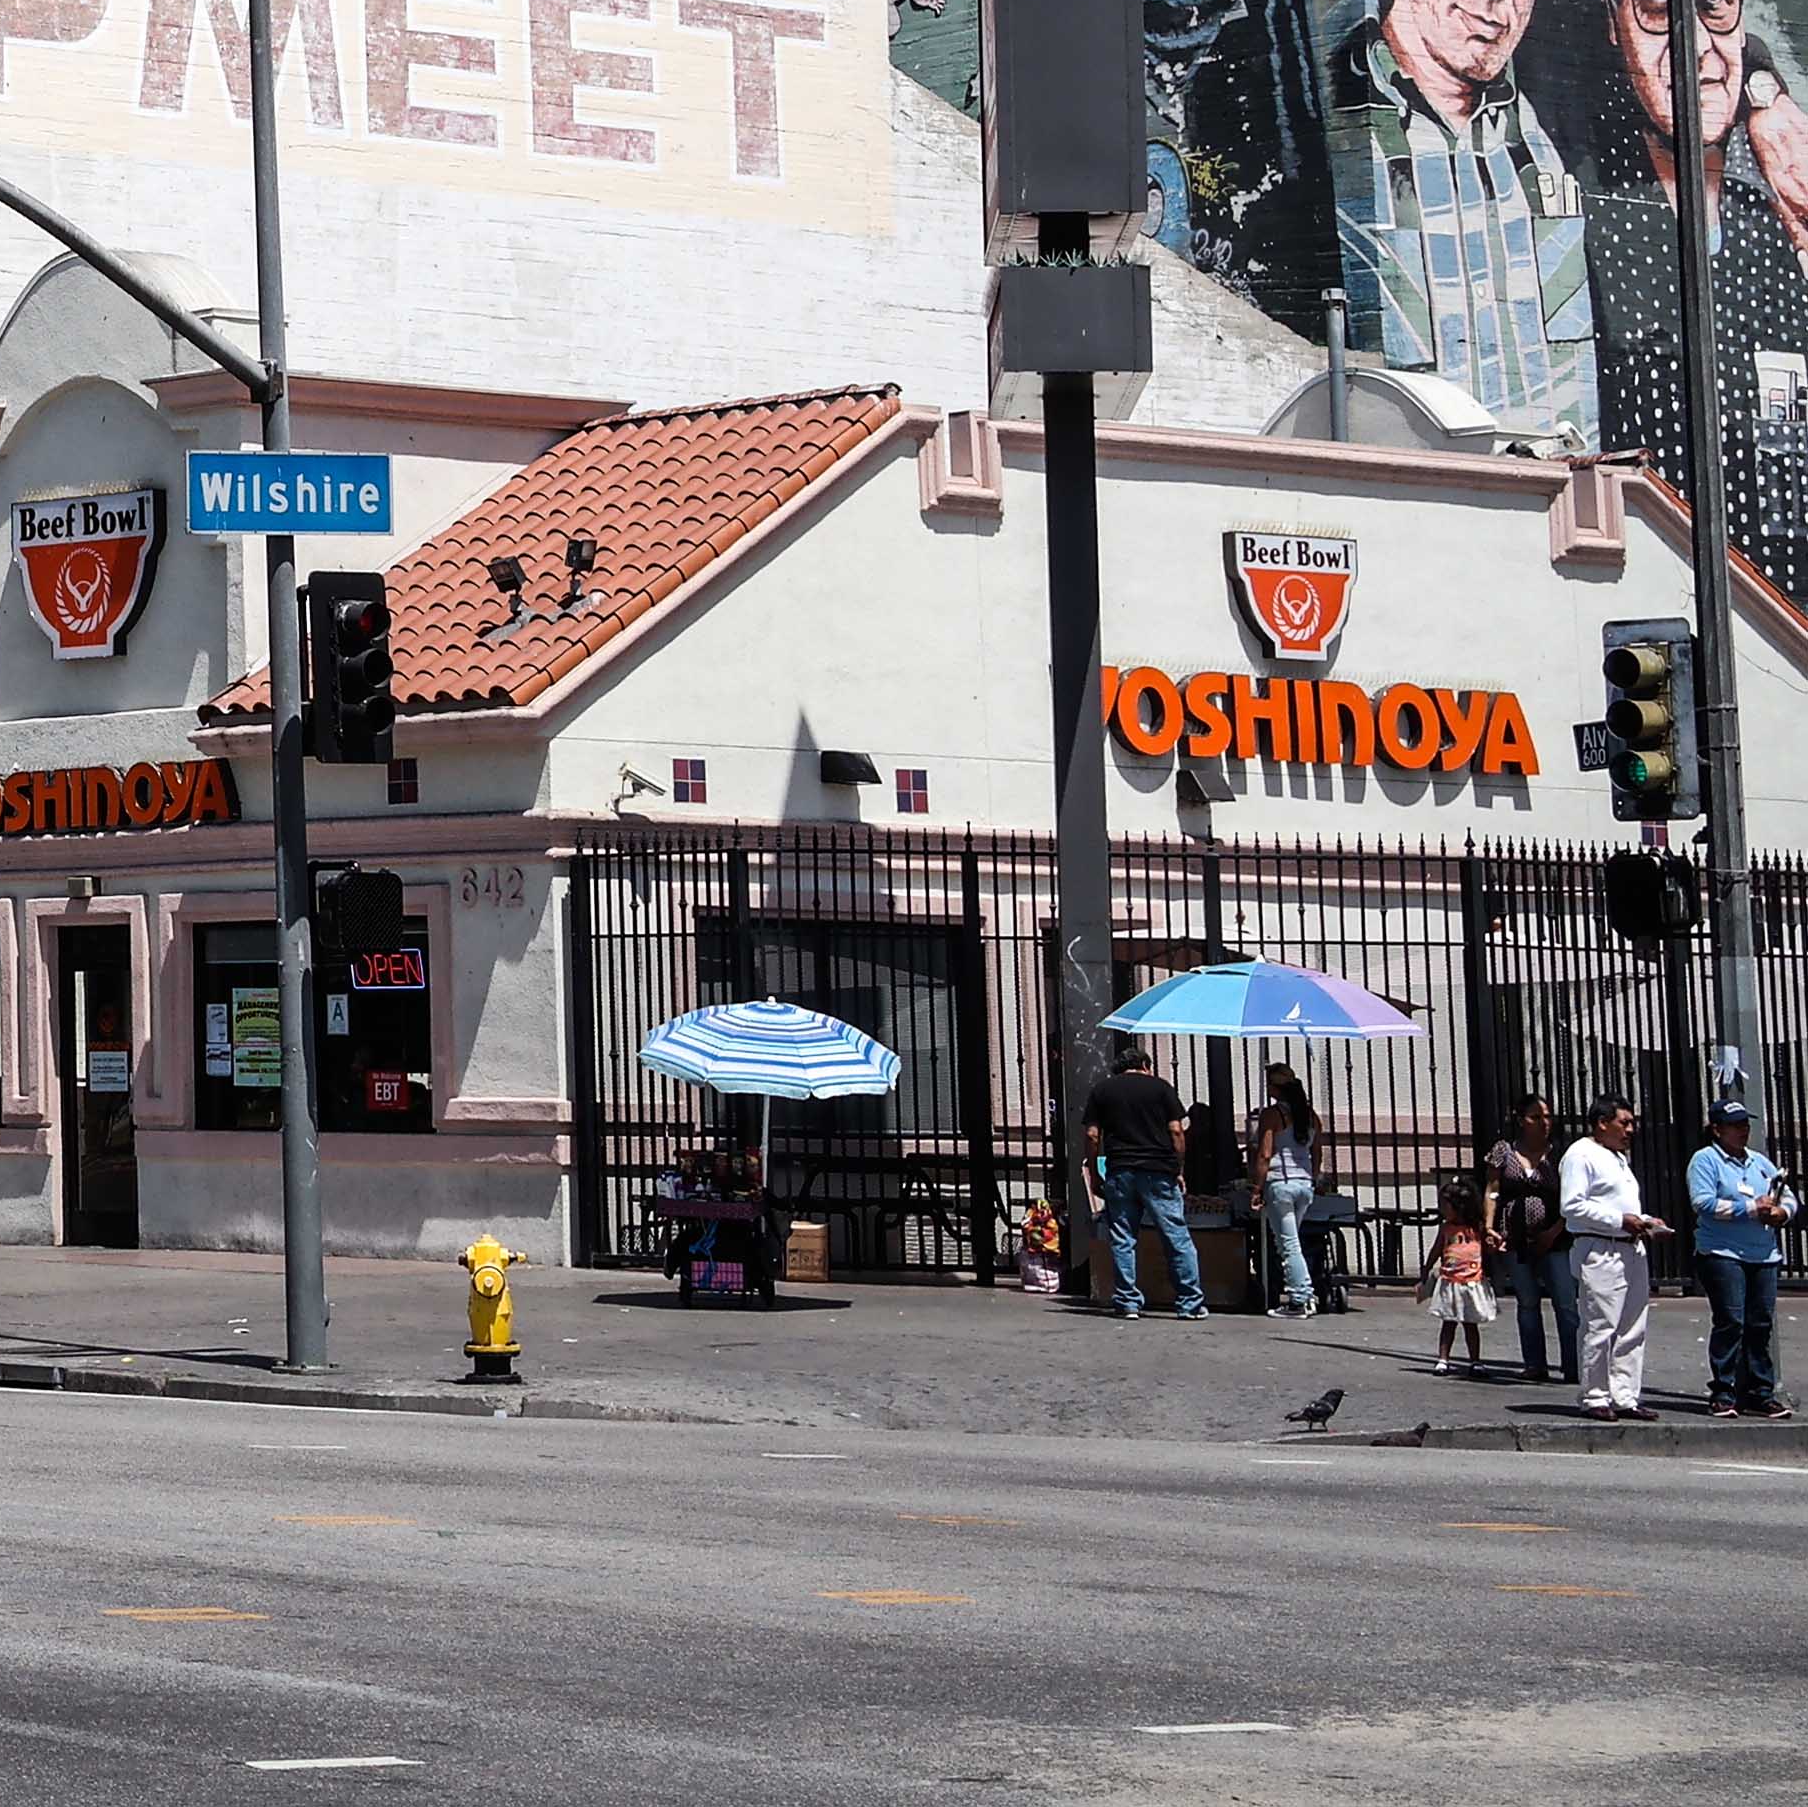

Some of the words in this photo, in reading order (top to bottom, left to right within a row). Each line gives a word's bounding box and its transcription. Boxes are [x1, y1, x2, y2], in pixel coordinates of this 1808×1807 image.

[201, 472, 380, 515] Wilshire
[19, 504, 76, 543] Beef
[82, 495, 148, 533] Bowl
[1241, 536, 1290, 565] Beef
[1296, 540, 1351, 570] Bowl
[1583, 748, 1606, 767] 600
[460, 867, 526, 909] 642
[355, 953, 423, 984] OPEN
[332, 1001, 345, 1022] A
[374, 1082, 400, 1102] EBT
